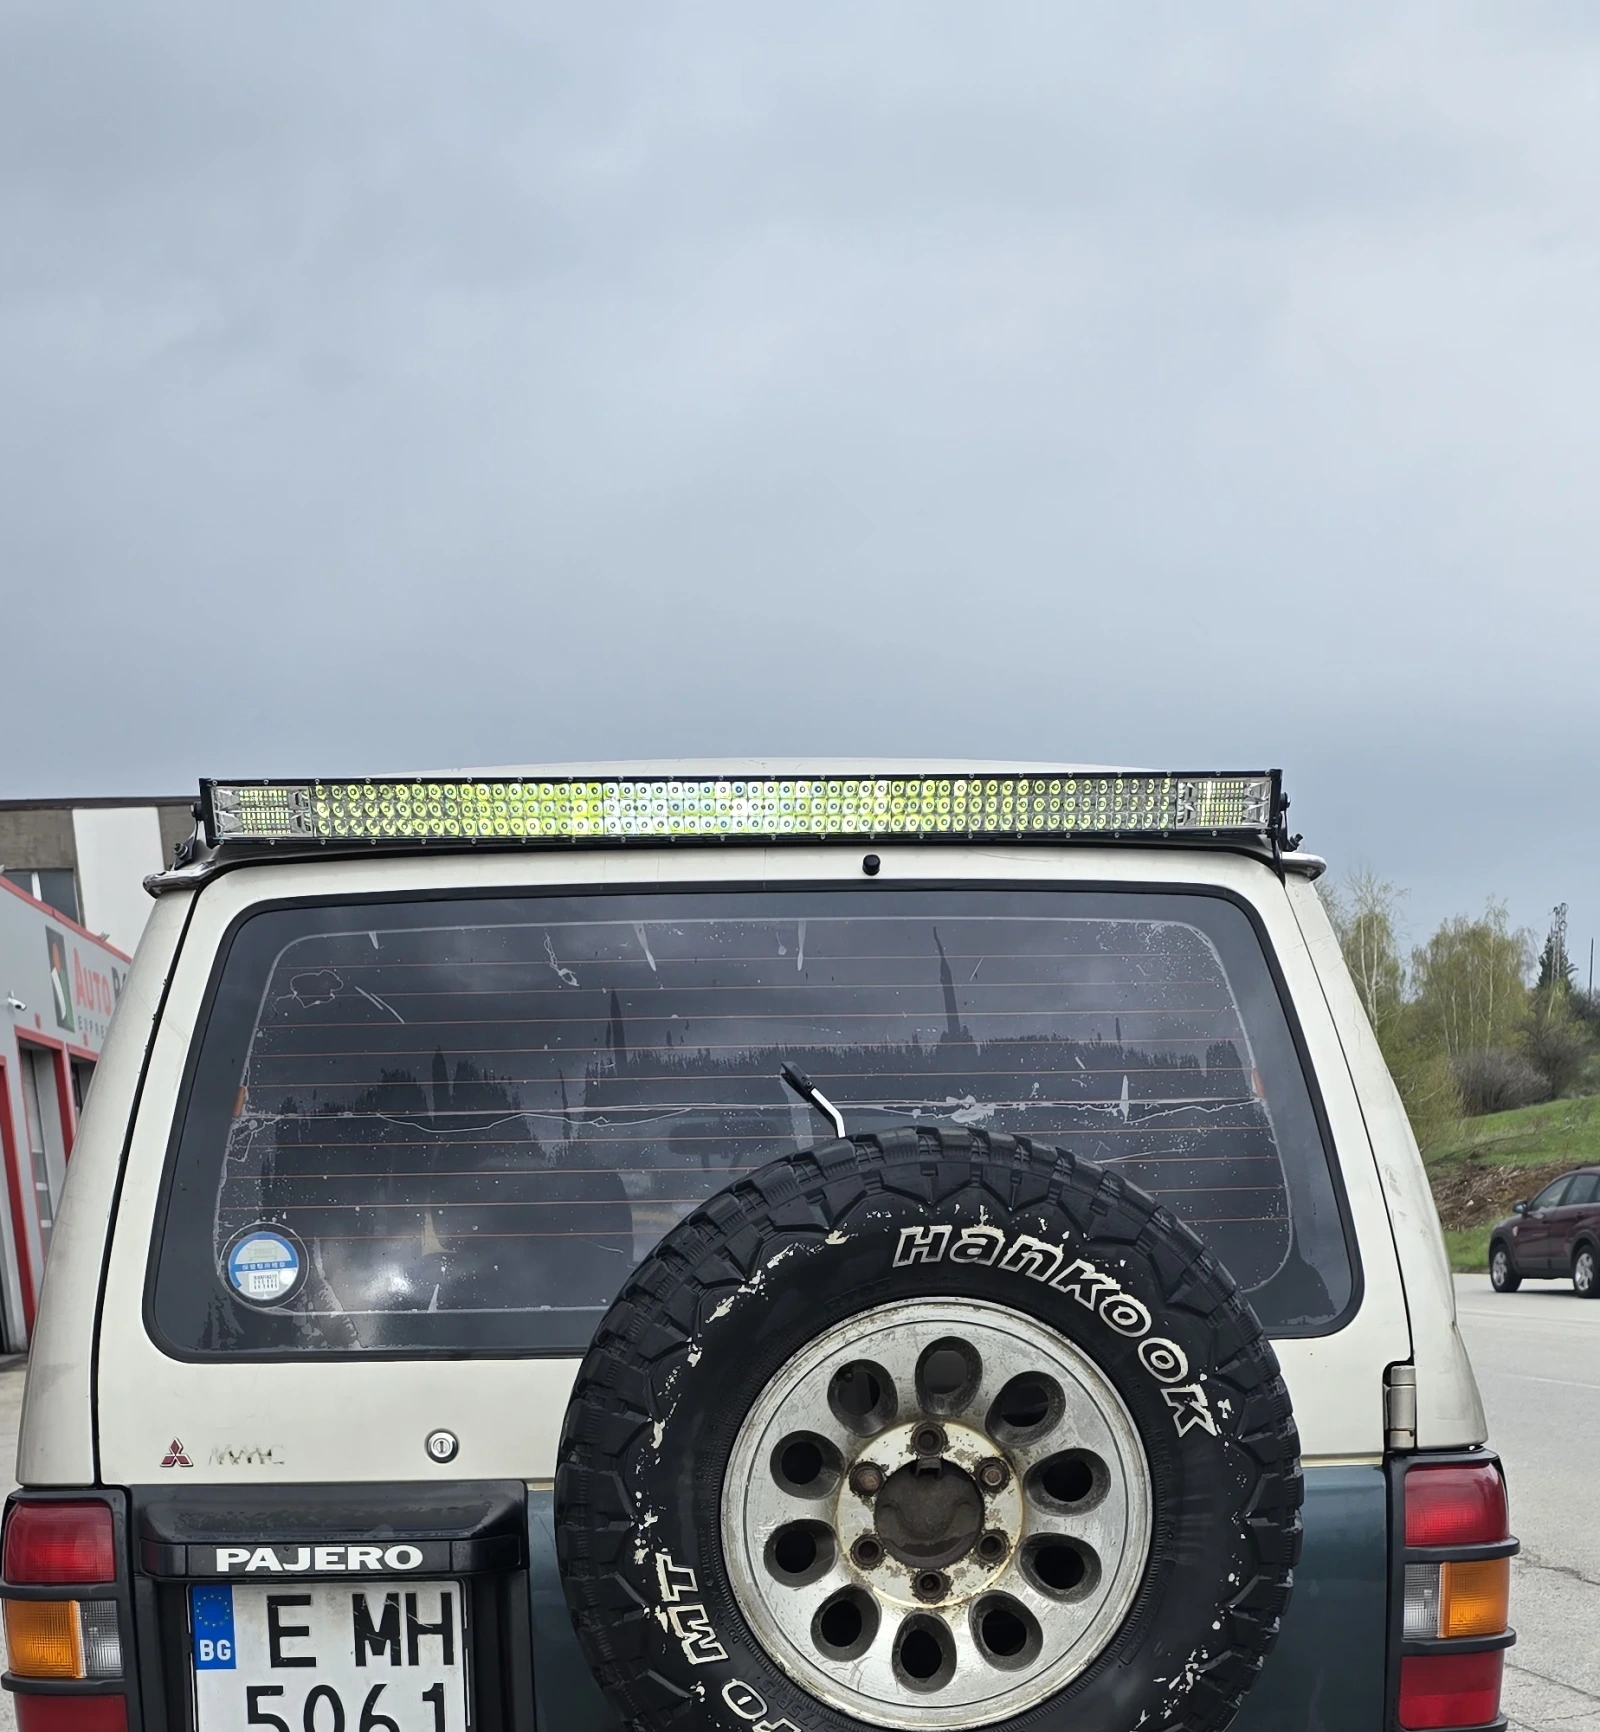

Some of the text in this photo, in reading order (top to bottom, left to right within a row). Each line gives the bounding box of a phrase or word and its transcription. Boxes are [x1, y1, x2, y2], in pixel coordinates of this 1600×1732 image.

[73, 947, 112, 1017] AUTO
[216, 1545, 423, 1572] PAJERO
[266, 1591, 455, 1668] E MH
[655, 1552, 729, 1665] MT
[199, 1639, 232, 1661] BG
